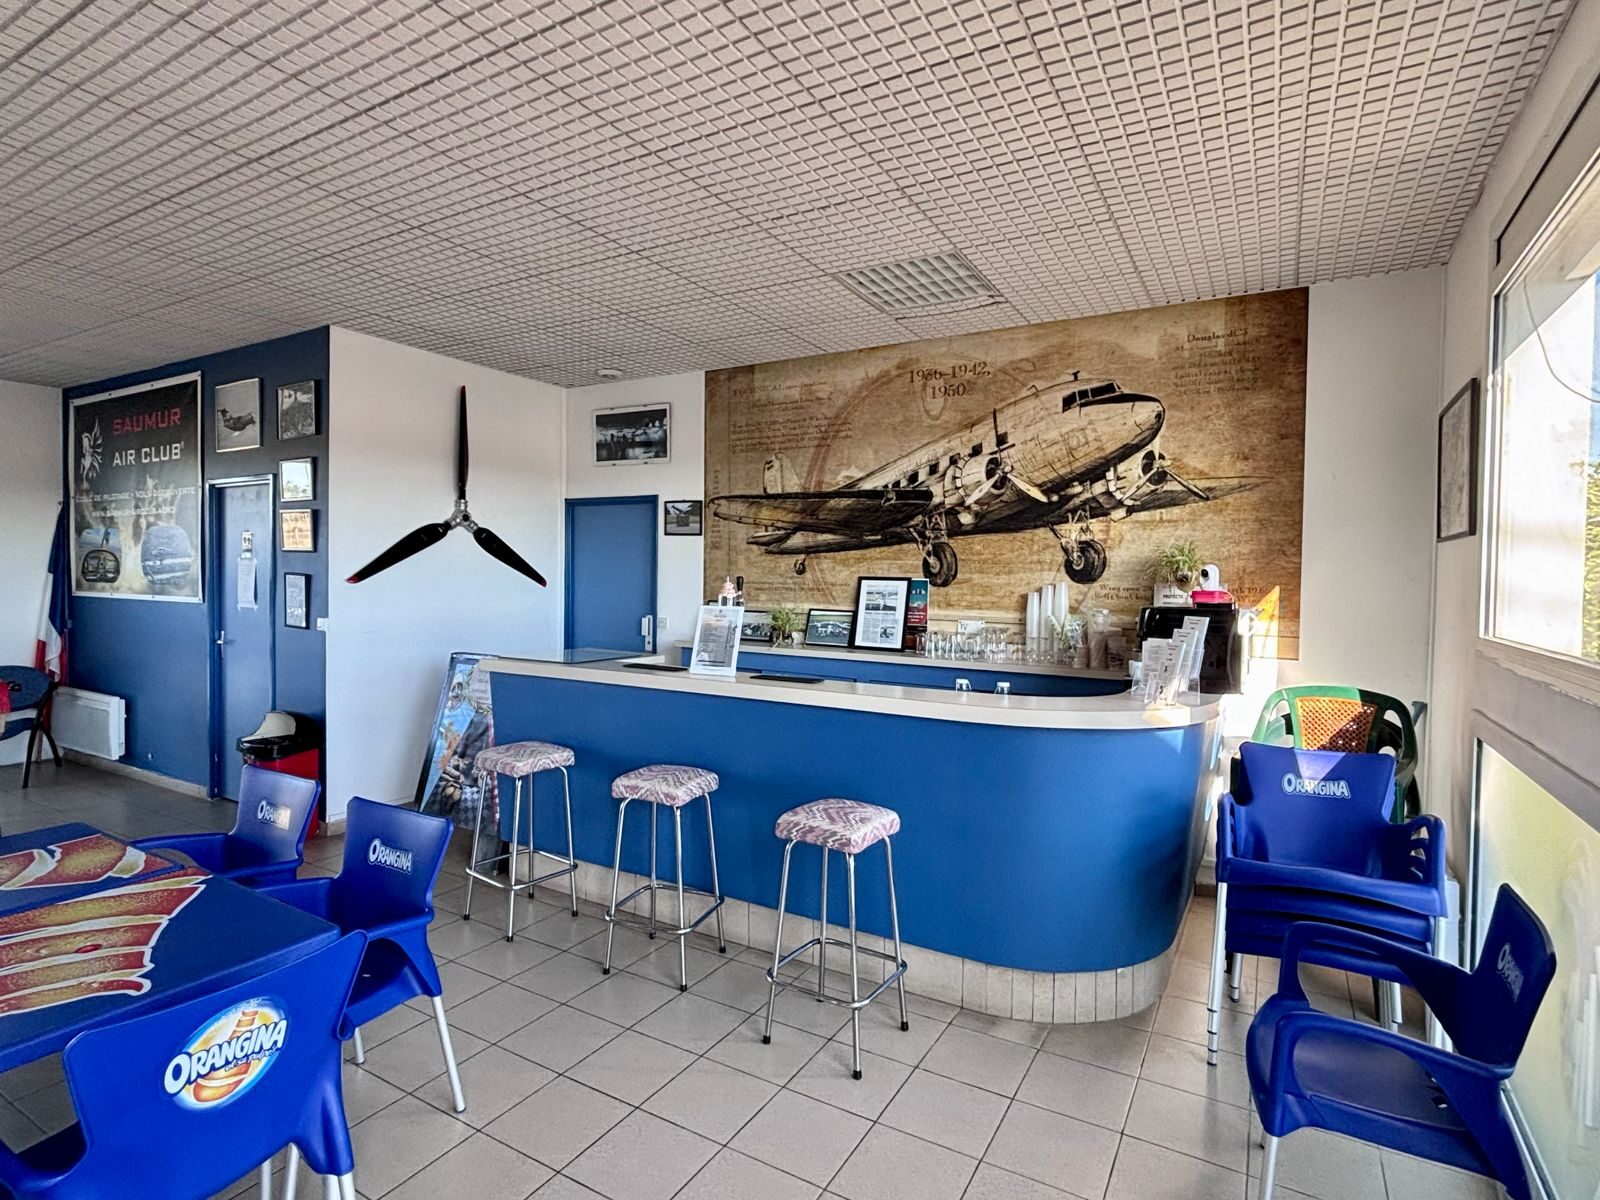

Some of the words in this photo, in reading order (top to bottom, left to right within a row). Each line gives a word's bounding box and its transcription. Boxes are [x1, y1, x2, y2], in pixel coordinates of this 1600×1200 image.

[931, 382, 967, 400] 1950
[112, 407, 182, 436] SAUMUR
[112, 449, 136, 467] AIR
[141, 443, 181, 464] CLUB
[1282, 772, 1350, 798] ORANGINA
[368, 838, 412, 873] ORANGINA
[164, 1019, 288, 1095] ORANGINA
